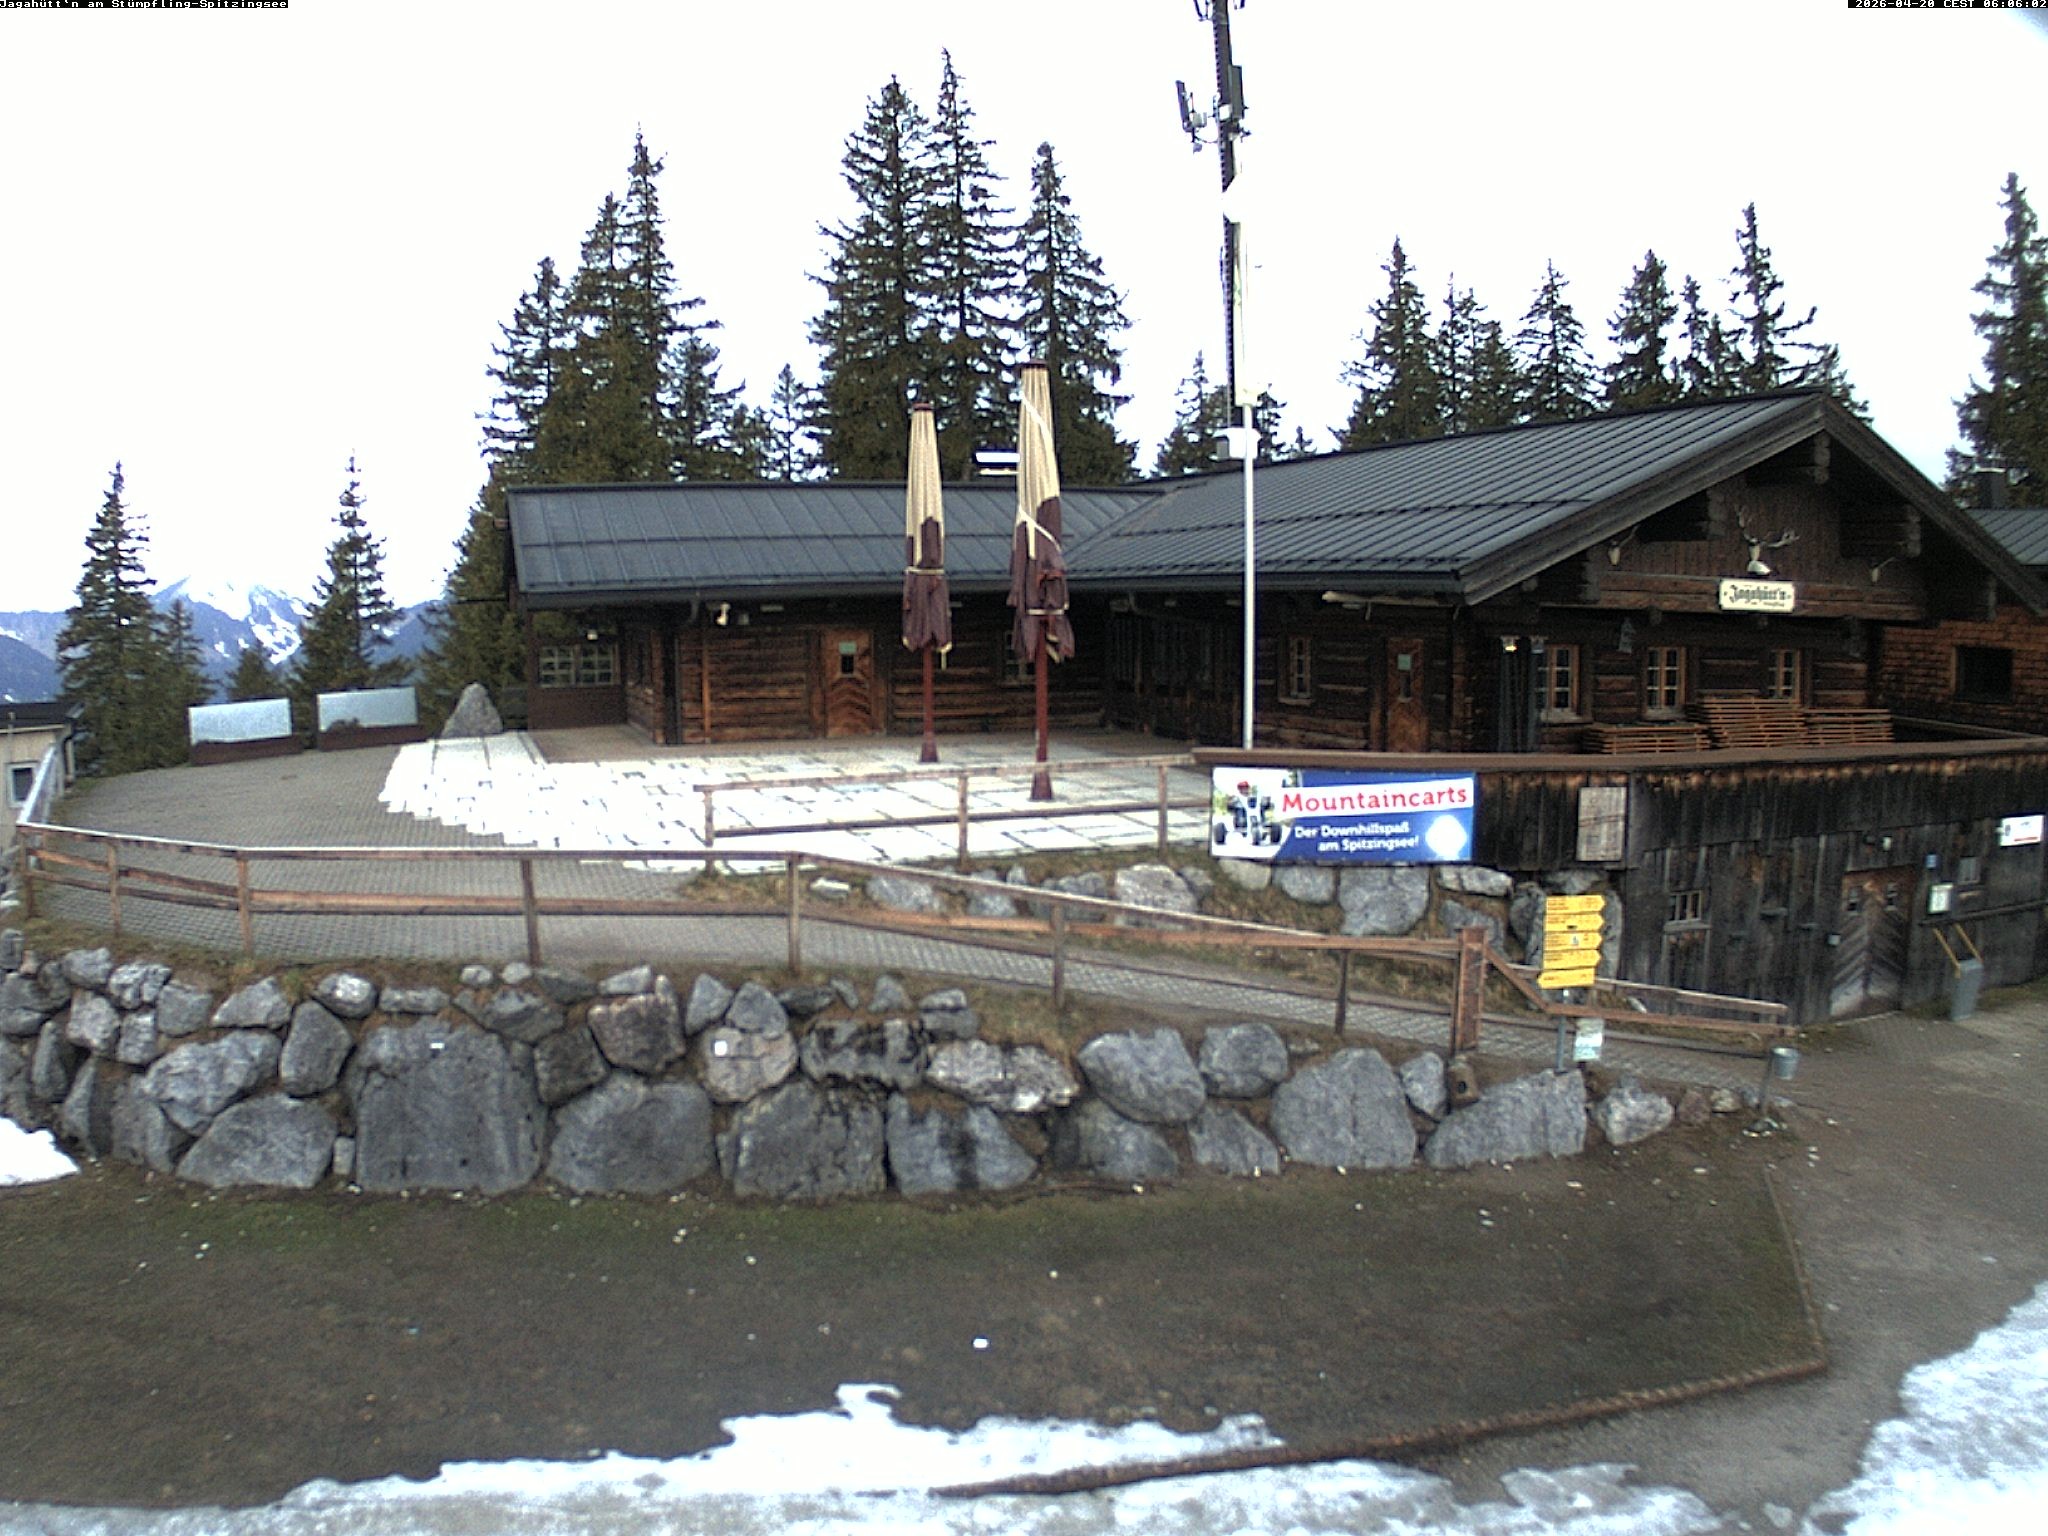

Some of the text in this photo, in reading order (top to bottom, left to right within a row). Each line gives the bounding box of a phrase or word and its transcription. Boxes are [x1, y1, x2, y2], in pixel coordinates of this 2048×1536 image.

[1282, 786, 1467, 812] Mountaincarts
[1295, 826, 1318, 838] Der
[1318, 841, 1340, 852] am
